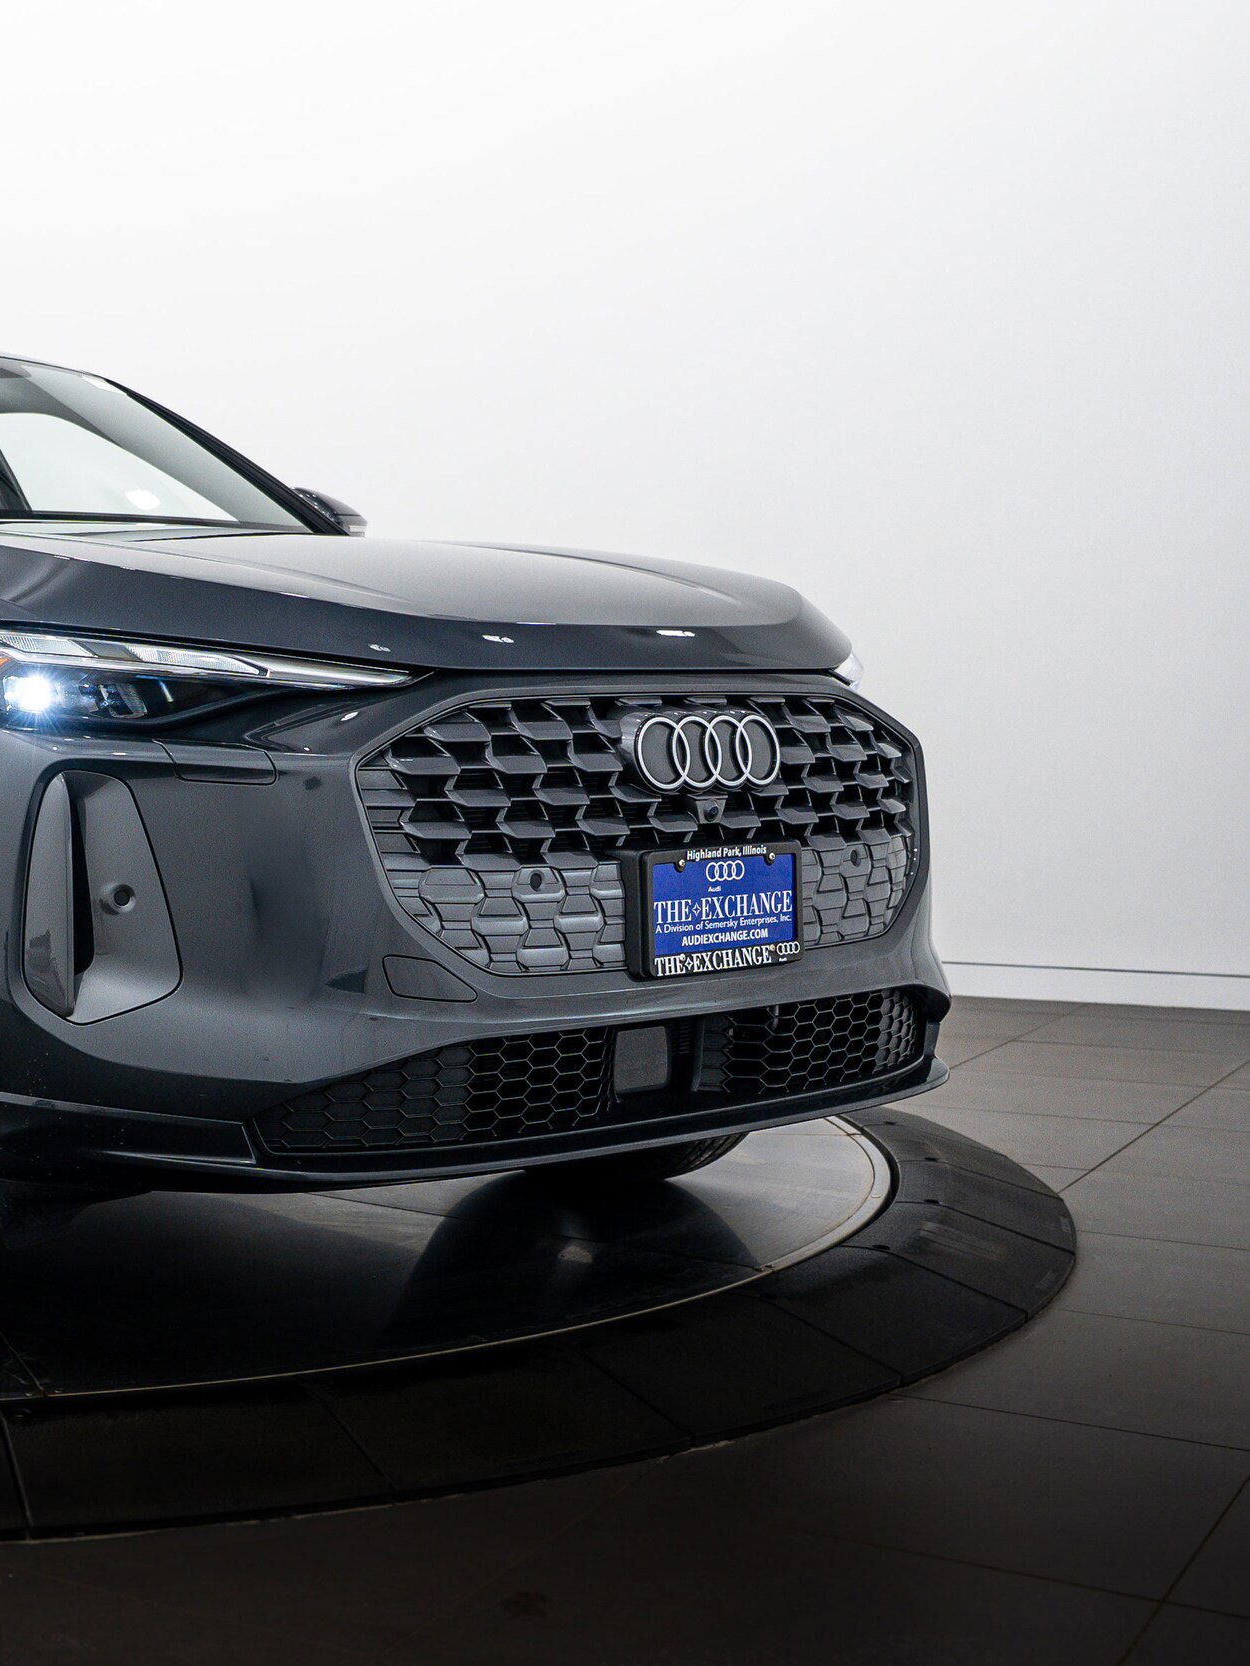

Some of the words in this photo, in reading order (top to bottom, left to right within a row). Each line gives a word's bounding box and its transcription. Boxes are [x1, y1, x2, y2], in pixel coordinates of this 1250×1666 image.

[687, 847, 722, 861] Highland
[723, 846, 742, 857] Park,
[742, 844, 767, 856] Illinois
[654, 899, 692, 924] THE
[700, 890, 793, 920] EXCHANGE
[655, 925, 662, 934] A
[664, 924, 693, 933] Division
[695, 921, 704, 930] of
[704, 919, 738, 930] Semersky
[739, 915, 779, 927] Enterprises,
[780, 913, 792, 922] Inc.
[681, 928, 769, 947] AUDIEXCHANGE.COM
[654, 955, 686, 977] THE
[691, 945, 772, 973] EXCHANGE
